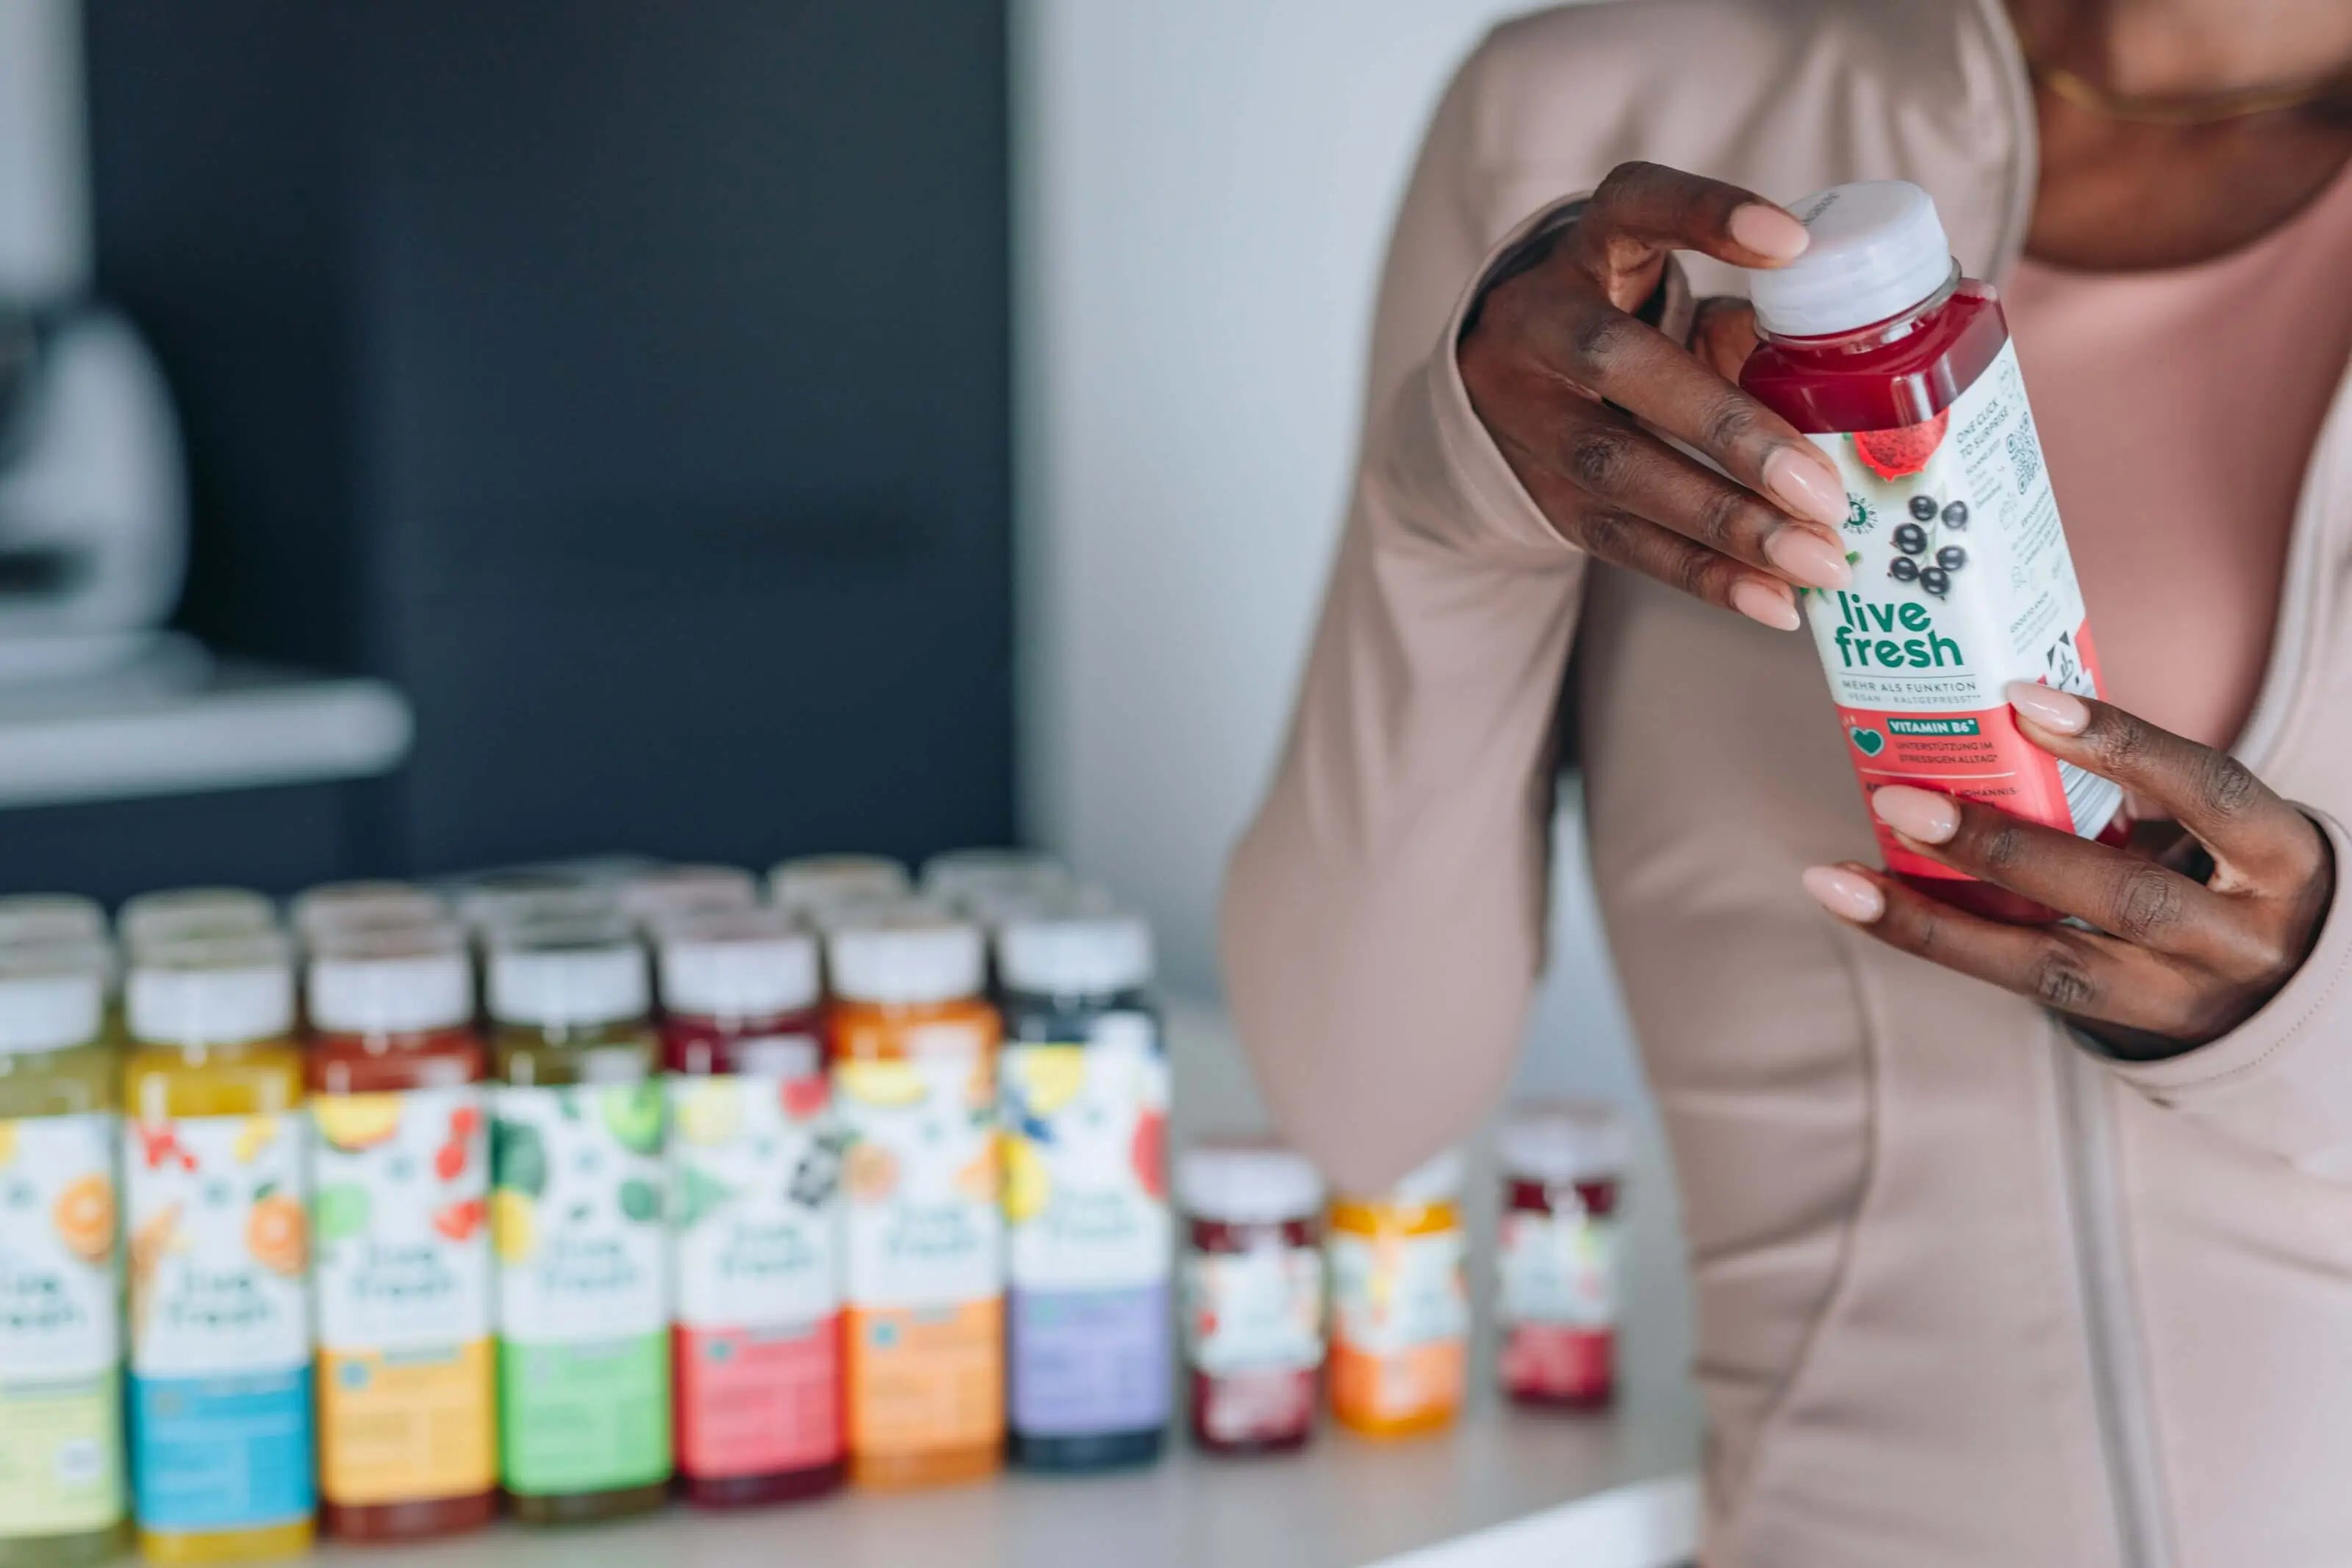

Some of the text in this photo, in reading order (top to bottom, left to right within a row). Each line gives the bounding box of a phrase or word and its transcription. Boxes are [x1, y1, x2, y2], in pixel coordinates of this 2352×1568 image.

[1957, 399, 1998, 444] ONE CLICK
[1959, 443, 1973, 459] TO
[1973, 405, 2009, 448] SURPRISE
[1837, 591, 1932, 633] live
[1835, 626, 1965, 669] fresh
[1842, 680, 1976, 692] MEHR ALS FUNKTION
[1847, 692, 1882, 702] VEGAN
[1890, 721, 1949, 733] VITAMIN
[1895, 741, 1994, 751] UNTERSTÜTZUNG IM
[1899, 754, 1956, 763] STRESSIGEN
